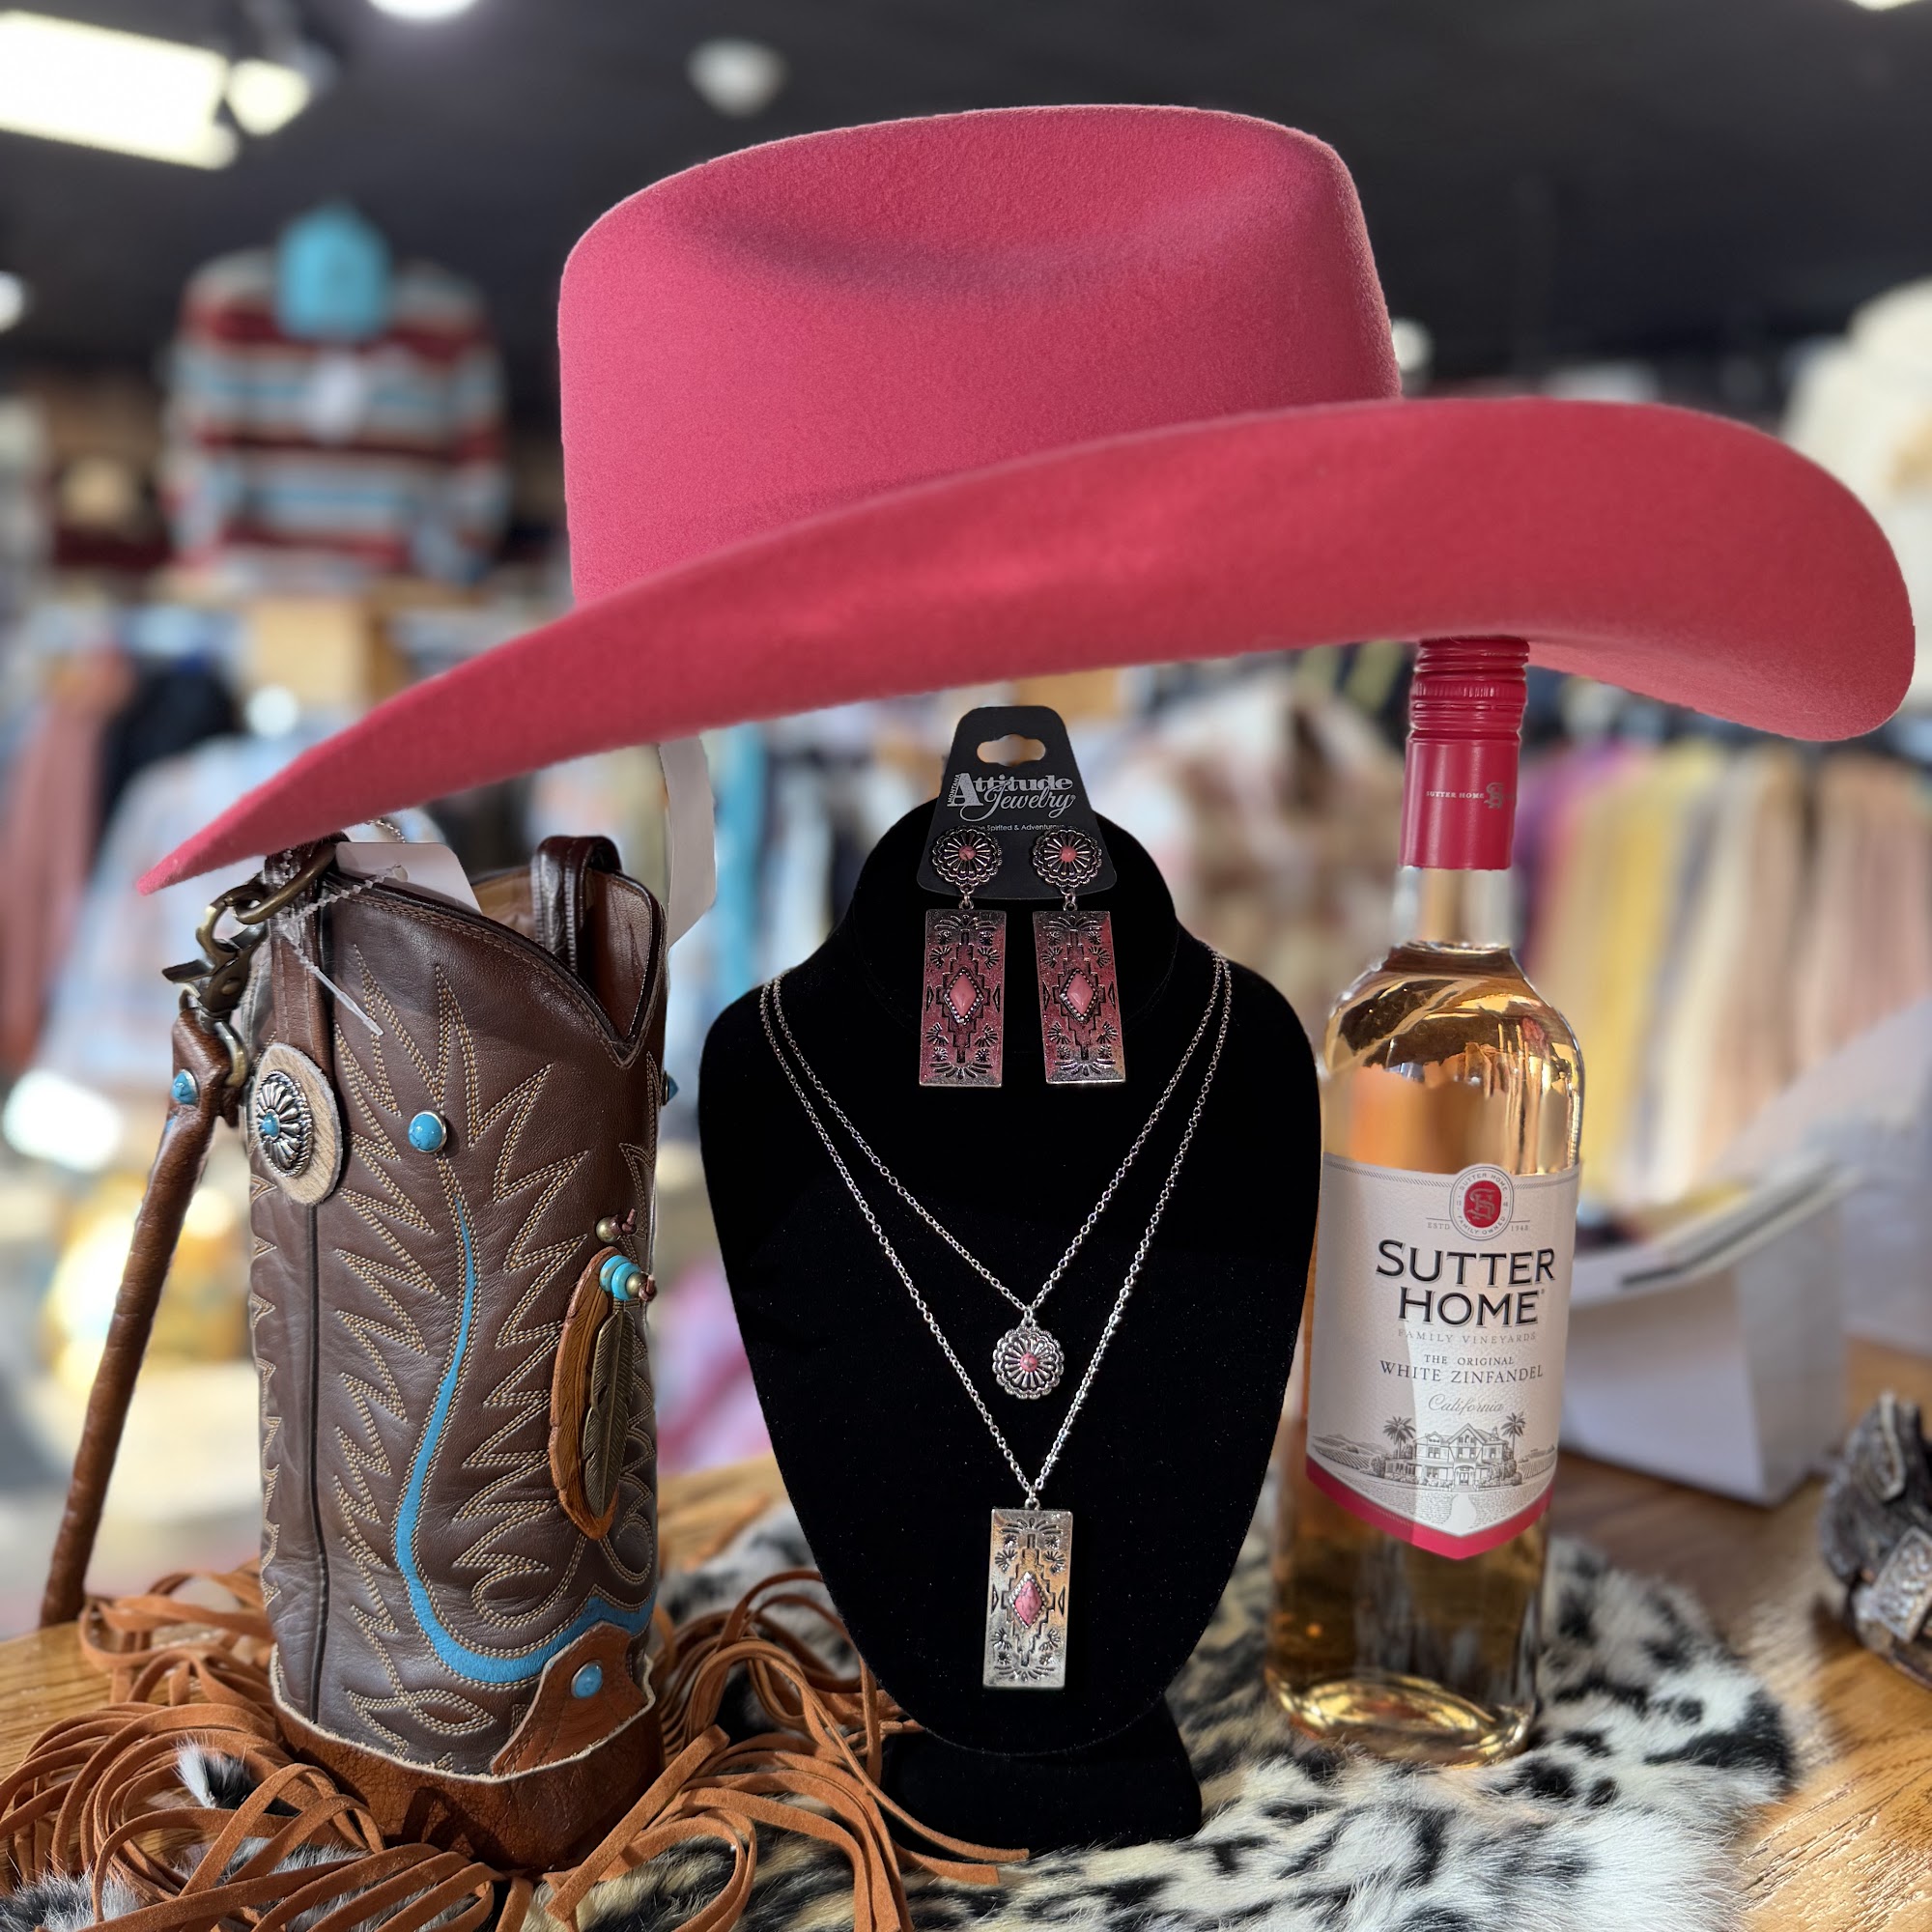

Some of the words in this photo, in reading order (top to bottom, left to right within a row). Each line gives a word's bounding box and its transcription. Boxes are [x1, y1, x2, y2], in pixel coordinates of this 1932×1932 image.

[947, 773, 1073, 807] Attitude
[960, 781, 1076, 821] Jewelry
[1460, 1172, 1488, 1191] SUTTER
[1491, 1174, 1508, 1191] HOME
[1458, 1215, 1480, 1235] FAMILY
[1482, 1215, 1506, 1236] OWNED
[1376, 1239, 1556, 1288] SUTTER
[1398, 1287, 1539, 1328] HOME
[1398, 1329, 1454, 1344] FAMILY
[1463, 1331, 1537, 1345] VINEYARDS
[1424, 1354, 1448, 1365] THE
[1457, 1356, 1515, 1366] ORIGINAL
[1379, 1360, 1441, 1382] WHITE
[1450, 1364, 1544, 1384] ZINFANDEL
[1428, 1393, 1504, 1416] California
